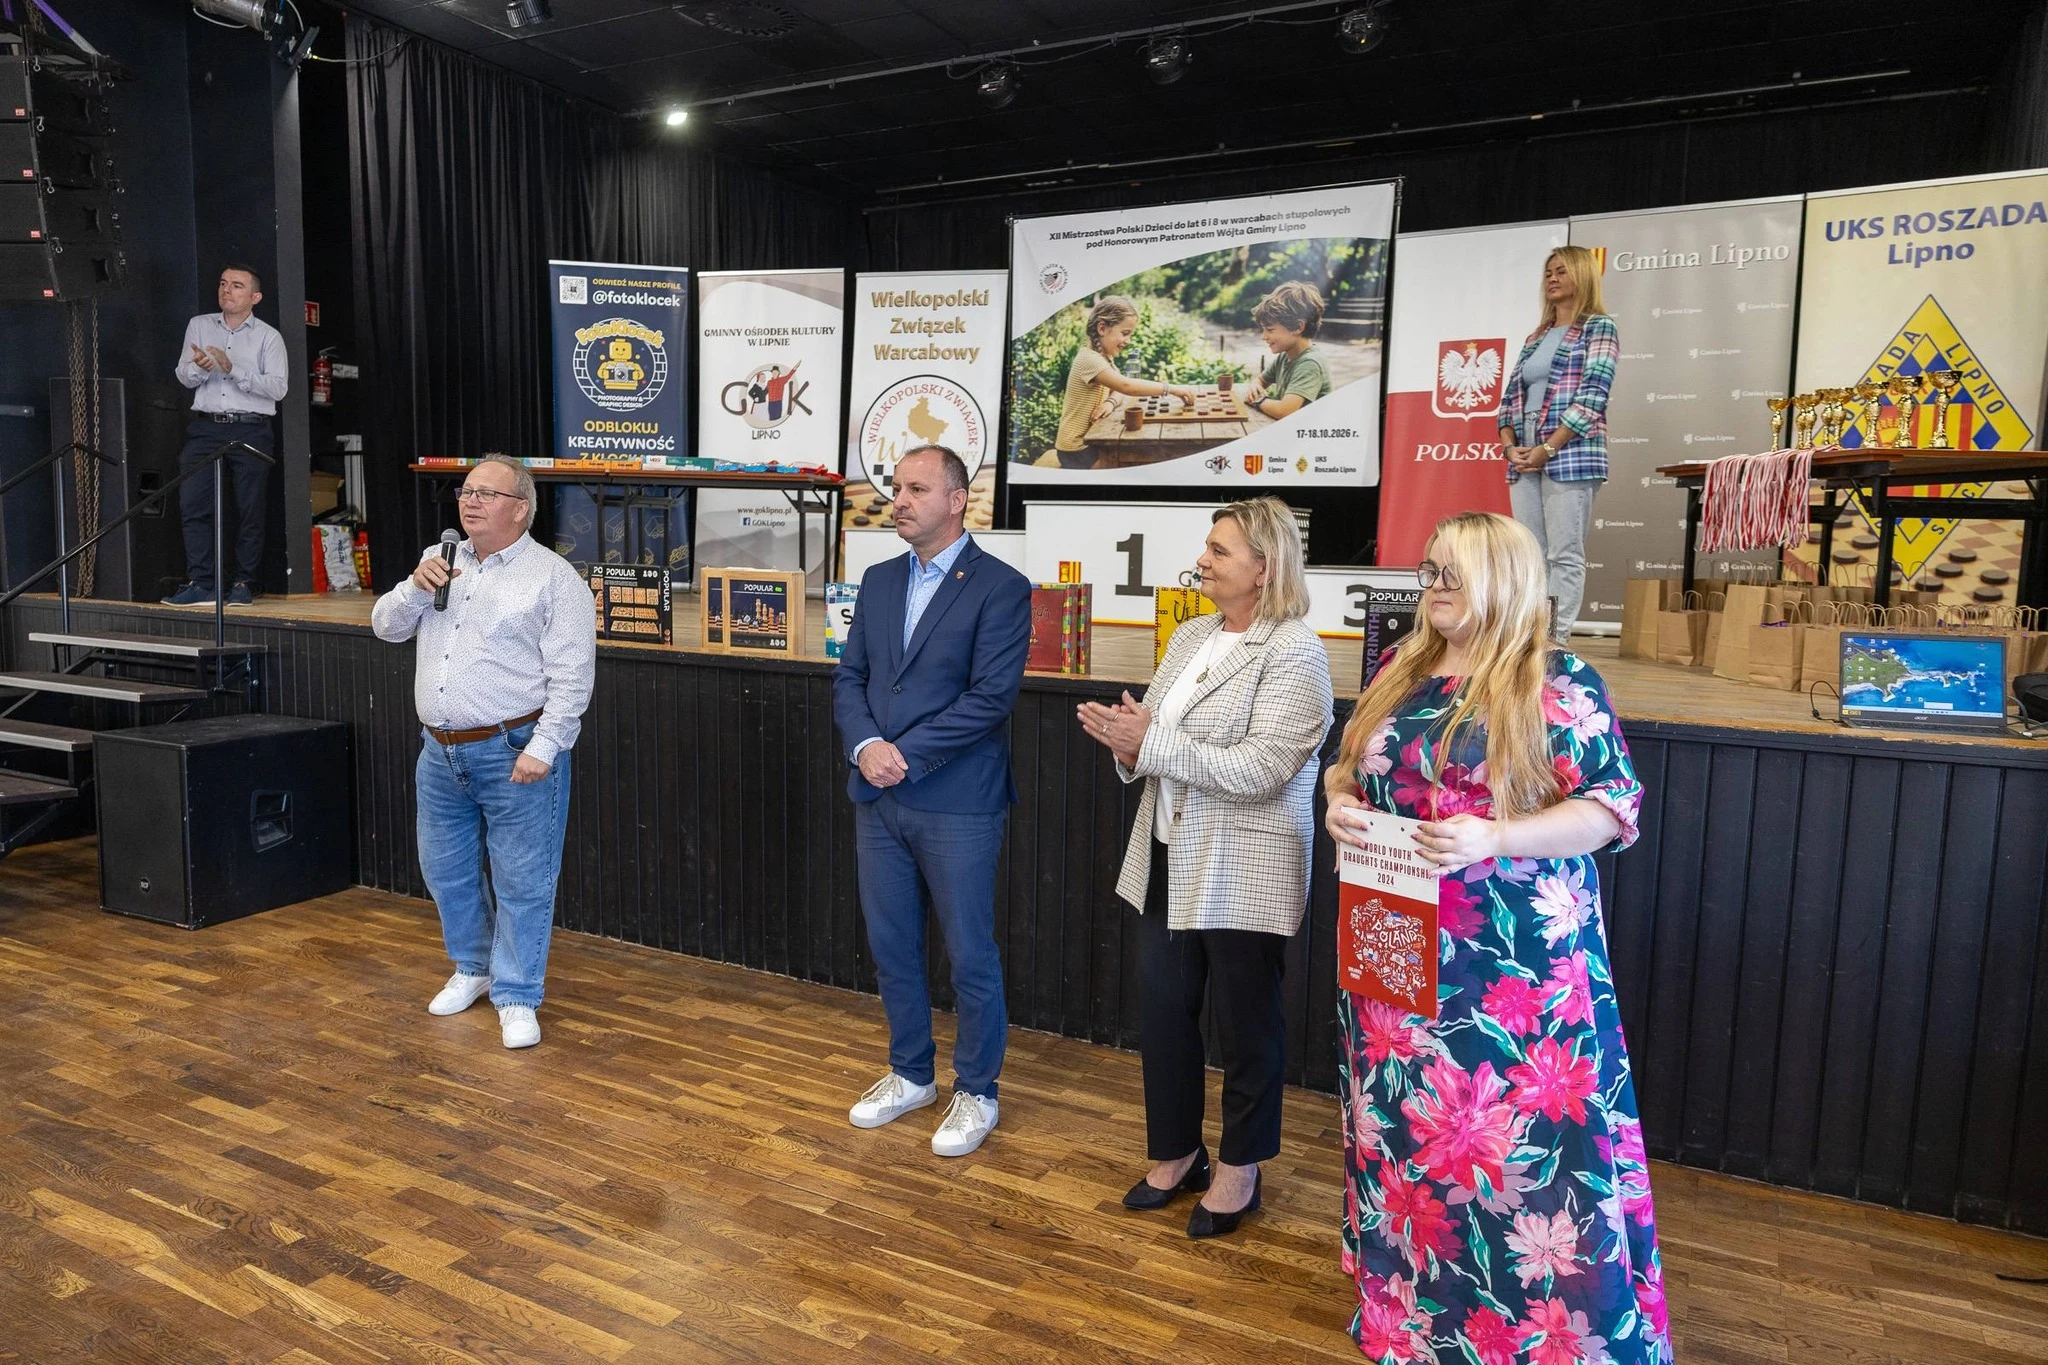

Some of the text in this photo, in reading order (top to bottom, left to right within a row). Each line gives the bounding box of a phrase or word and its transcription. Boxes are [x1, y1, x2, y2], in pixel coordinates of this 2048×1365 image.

[1050, 232, 1060, 240] XII
[1062, 229, 1115, 239] Mistrzostwa
[1116, 225, 1144, 234] Polski
[1145, 222, 1172, 232] Dzieci
[1187, 220, 1200, 228] lat
[1201, 218, 1206, 226] 6
[1213, 218, 1218, 226] 8
[1230, 212, 1283, 224] warcabach
[1285, 206, 1351, 220] stupolowych
[1825, 202, 2048, 242] UKS ROSZADA
[1086, 223, 1306, 249] pod Honorowym Patronatem Wójta Gminy Lipno
[1612, 242, 1790, 272] Gmina Lipno
[1888, 241, 1975, 268] Lipno
[628, 280, 651, 288] NASZE
[652, 282, 681, 290] PROFILE
[592, 290, 681, 306] @fotoklocek
[872, 289, 990, 311] Wielkopolski
[704, 326, 836, 337] GMINNY OŚRODEK KULTURY
[890, 316, 966, 338] Związek
[759, 338, 790, 346] LIPNIE
[874, 343, 980, 364] Warcabowy
[1946, 343, 2004, 414] LIPNO
[868, 383, 943, 444] WIELKOPOLSKI
[584, 420, 658, 434] ODBLOKUJ
[752, 430, 780, 440] LIPNO
[568, 435, 675, 450] KREATYWNOŚĆ
[1414, 443, 1504, 461] POLSK
[737, 506, 791, 515] www.goklipno.pl
[606, 568, 636, 576] POPULAR
[1115, 533, 1154, 597] 1
[744, 584, 773, 592] POPULAR
[1370, 592, 1418, 602] POPULAR
[1344, 584, 1371, 627] 3
[1389, 847, 1412, 860] YOUTH
[1344, 851, 1432, 880] DRAUGHTS CHAMPIONSHI
[1378, 873, 1394, 885] 2024
[1371, 919, 1418, 948] POLAND
